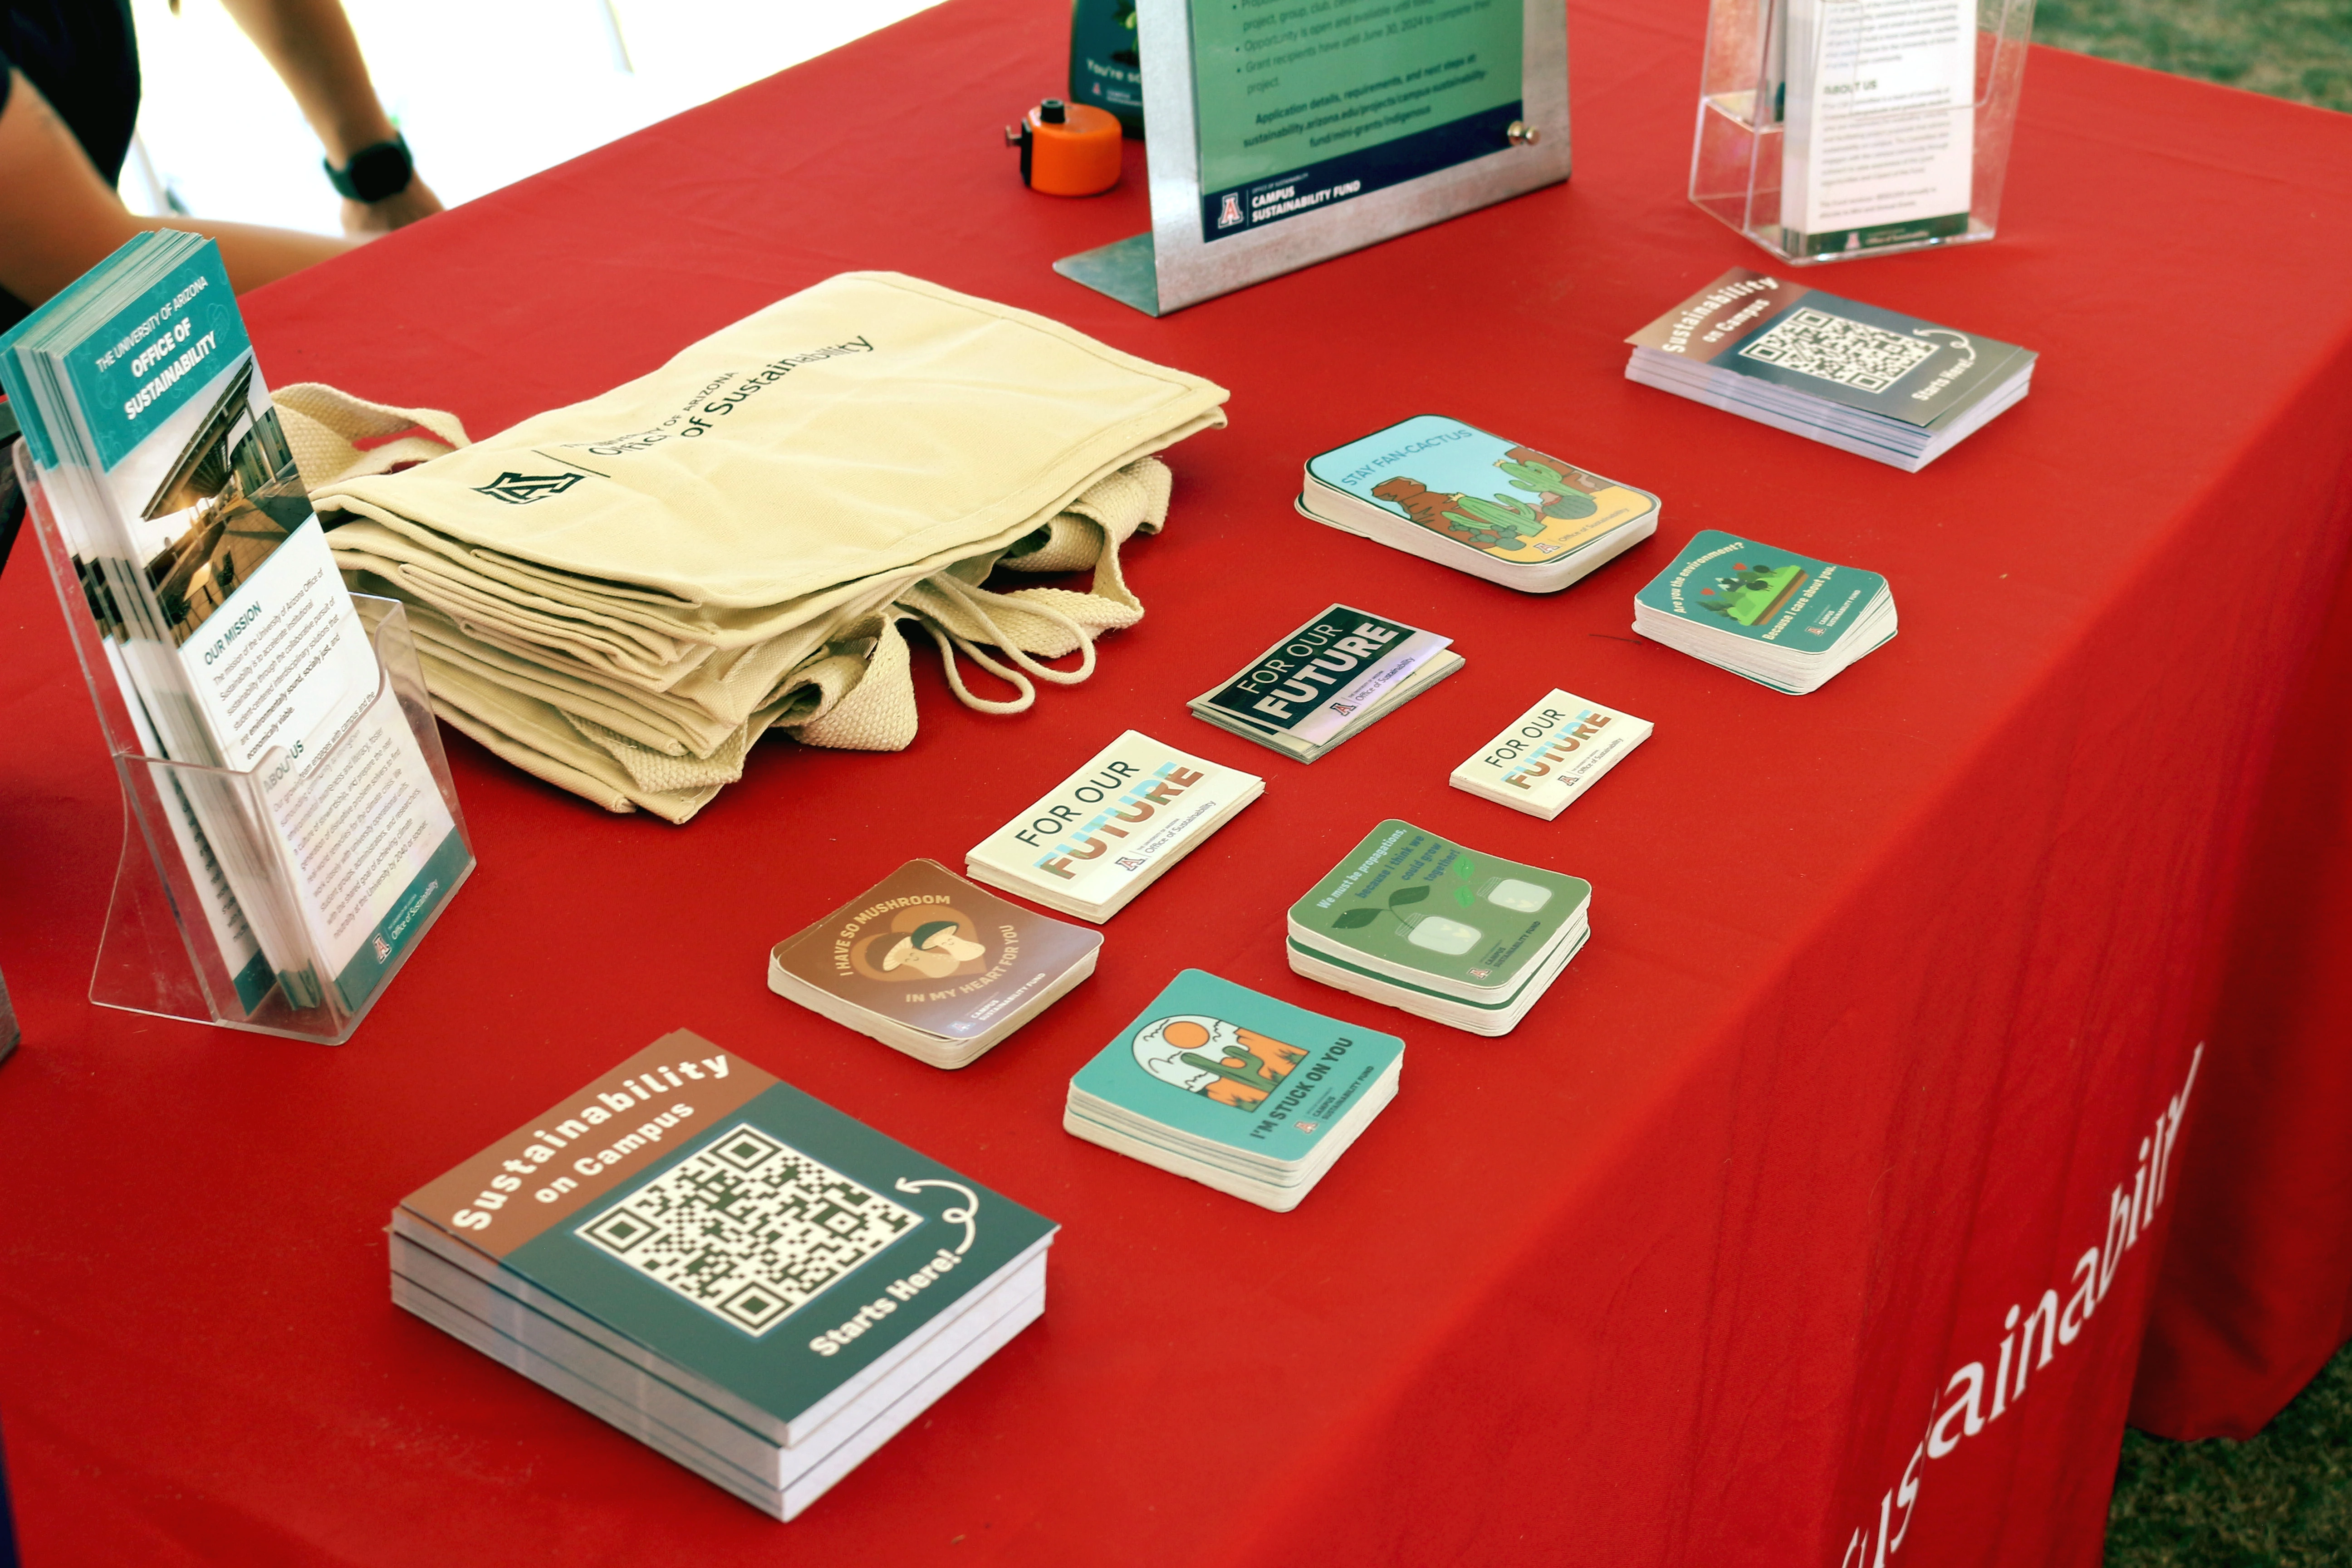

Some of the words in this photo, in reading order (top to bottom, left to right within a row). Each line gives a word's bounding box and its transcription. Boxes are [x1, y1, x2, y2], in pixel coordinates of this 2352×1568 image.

[1252, 186, 1295, 208] CAMPUS
[1252, 188, 1332, 223] SUSTAINABILITY
[1333, 180, 1361, 198] FUND
[95, 351, 116, 372] THE
[113, 312, 160, 358] UNIVERSITY
[161, 302, 172, 320] OF
[172, 276, 208, 311] ARIZONA
[1662, 276, 1779, 354] Sustainability
[1702, 326, 1724, 343] on
[1720, 298, 1770, 333] Campus
[131, 332, 176, 377] OFFICE
[173, 317, 191, 342] OF
[123, 330, 216, 420] SUSTAINABILITY
[681, 416, 713, 438] of
[704, 335, 874, 416] Sustainability
[683, 371, 739, 412] ARIZONA
[1911, 377, 1950, 401] Starts
[1341, 461, 1378, 487] STAY
[1374, 429, 1474, 469] FAN-CACTUS
[1670, 577, 1686, 587] the
[1679, 542, 1744, 577] environment?
[1671, 588, 1684, 601] you
[1672, 600, 1687, 613] Are
[1761, 615, 1793, 640] Because
[1791, 597, 1809, 612] care
[1803, 578, 1825, 598] about
[1818, 566, 1837, 580] you.
[1826, 599, 1853, 627] SUSTAINABILITY
[1848, 589, 1861, 600] FUND
[205, 639, 225, 665] OUR
[224, 601, 262, 646] MISSION
[1818, 610, 1835, 625] CAMPUS
[1237, 659, 1295, 694] FOR
[1286, 624, 1343, 657] OUR
[1252, 622, 1400, 719] FUTURE
[1355, 687, 1376, 701] Office
[1378, 657, 1415, 683] Sustainability
[289, 740, 304, 759] US
[1484, 739, 1529, 768] FOR
[1521, 709, 1566, 739] OUR
[1500, 709, 1612, 790] FUTURE
[1015, 804, 1082, 848] FOR
[1074, 760, 1141, 804] OUR
[1032, 761, 1205, 880] FUTURE
[1145, 838, 1169, 853] Office
[1172, 800, 1217, 832] Sustainability
[1317, 897, 1336, 909] We
[1331, 879, 1354, 898] must
[1346, 871, 1362, 882] be
[1358, 829, 1407, 873] propagations,
[1354, 869, 1391, 899] because
[1388, 847, 1414, 866] think
[1409, 835, 1425, 847] we
[1401, 859, 1426, 881] could
[1421, 842, 1442, 862] grow
[840, 922, 860, 939] SO
[853, 894, 951, 925] MUSHROOM
[833, 939, 852, 971] HAVE
[998, 924, 1019, 946] YOU
[999, 946, 1019, 966] FOR
[906, 993, 925, 1003] IN
[929, 989, 957, 1002] MY
[959, 965, 1007, 994] HEART
[978, 985, 1029, 1021] SUSTAINABILITY
[1025, 972, 1046, 987] FUND
[970, 999, 1000, 1019] CAMPUS
[1250, 1120, 1279, 1140] I'M
[1269, 1081, 1315, 1120] STUCK
[1305, 1063, 1332, 1082] ON
[1321, 1037, 1353, 1062] YOU
[452, 1052, 730, 1231] Sustainability
[535, 1175, 577, 1203] on
[574, 1101, 694, 1177] Campus
[810, 1295, 895, 1357] Starts
[886, 1249, 962, 1303] Here!
